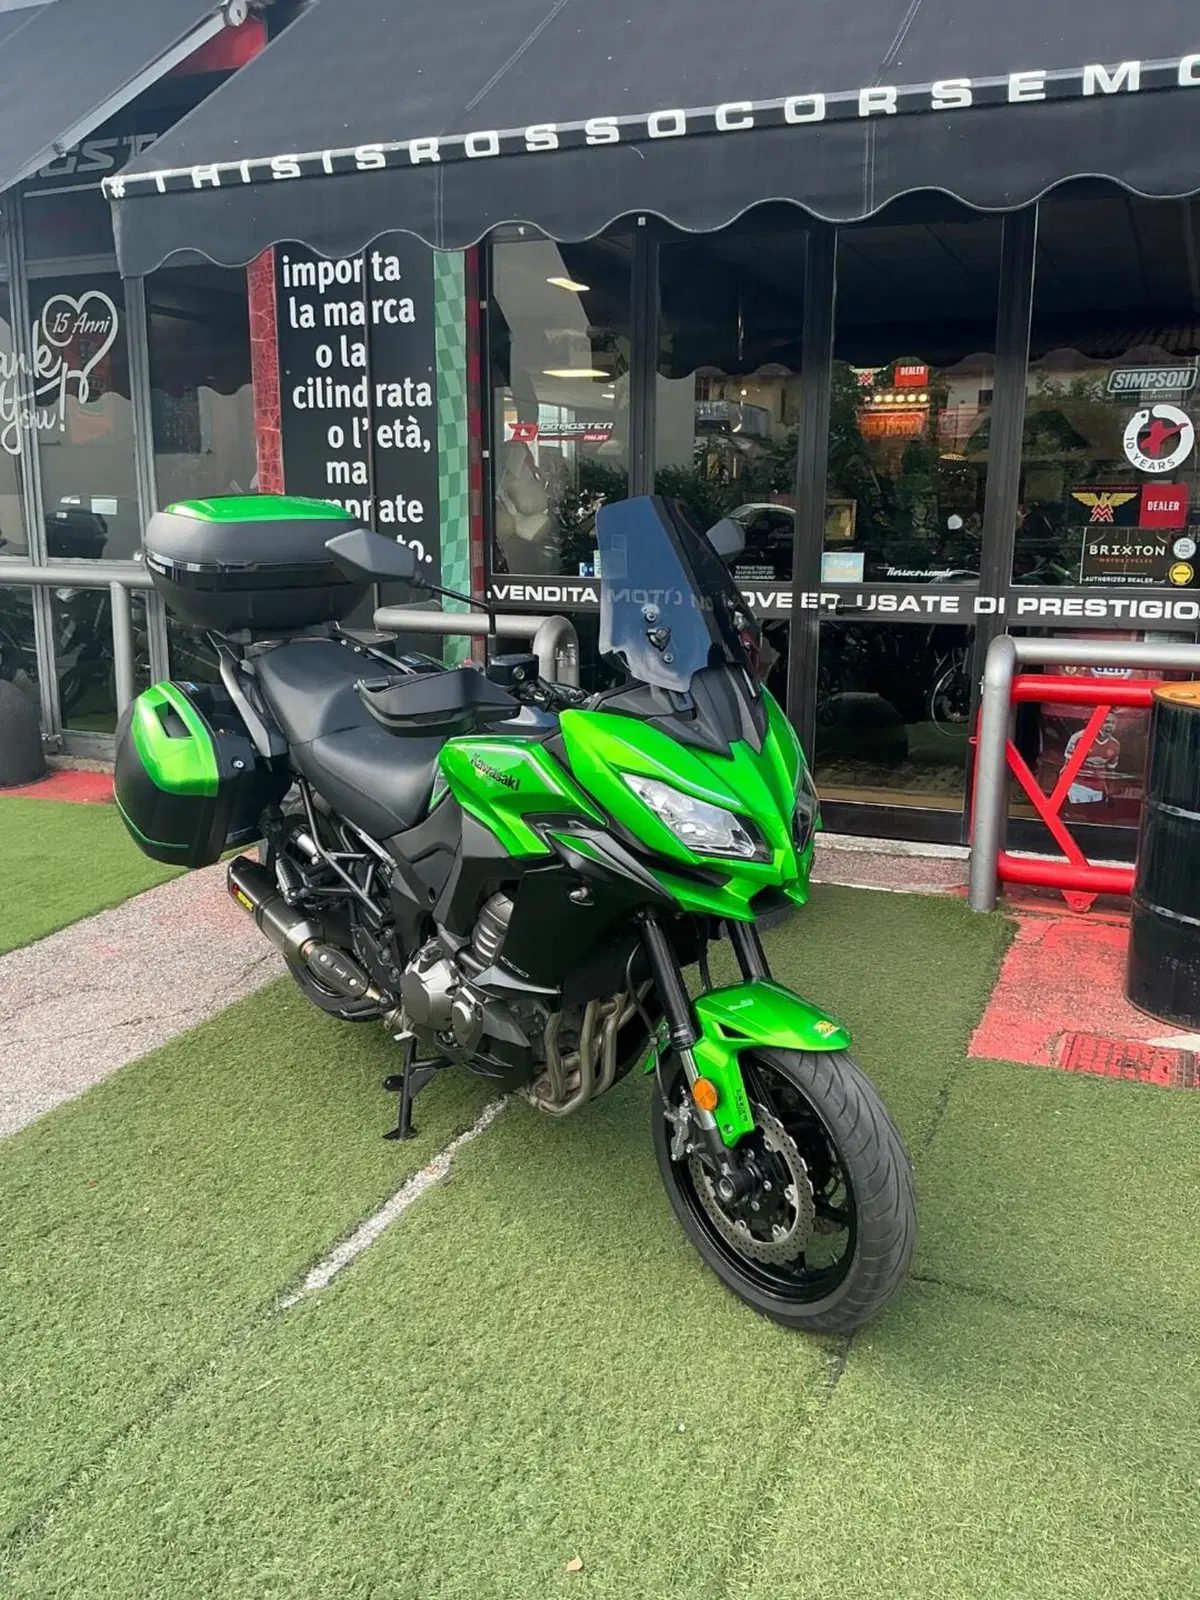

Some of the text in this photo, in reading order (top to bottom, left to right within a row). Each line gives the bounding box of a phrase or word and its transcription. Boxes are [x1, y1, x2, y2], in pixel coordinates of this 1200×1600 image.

[282, 251, 401, 294] importa
[52, 312, 111, 334] 15 Anni
[289, 296, 416, 329] la marca
[315, 335, 367, 369] o la
[292, 375, 432, 409] cilindrata
[1114, 371, 1190, 389] SIMPSON
[327, 425, 344, 449] o
[540, 422, 614, 430] DRAGSTER
[1126, 437, 1175, 470] 10 YEARS
[326, 461, 368, 484] ma
[1147, 501, 1180, 511] DEALER
[1089, 545, 1166, 556] BRIXTON
[492, 584, 599, 603] VENDITA
[856, 594, 959, 613] USATE
[974, 597, 1005, 614] DI
[1017, 597, 1199, 620] PRESTIGIO
[471, 753, 520, 791] Kawasaki
